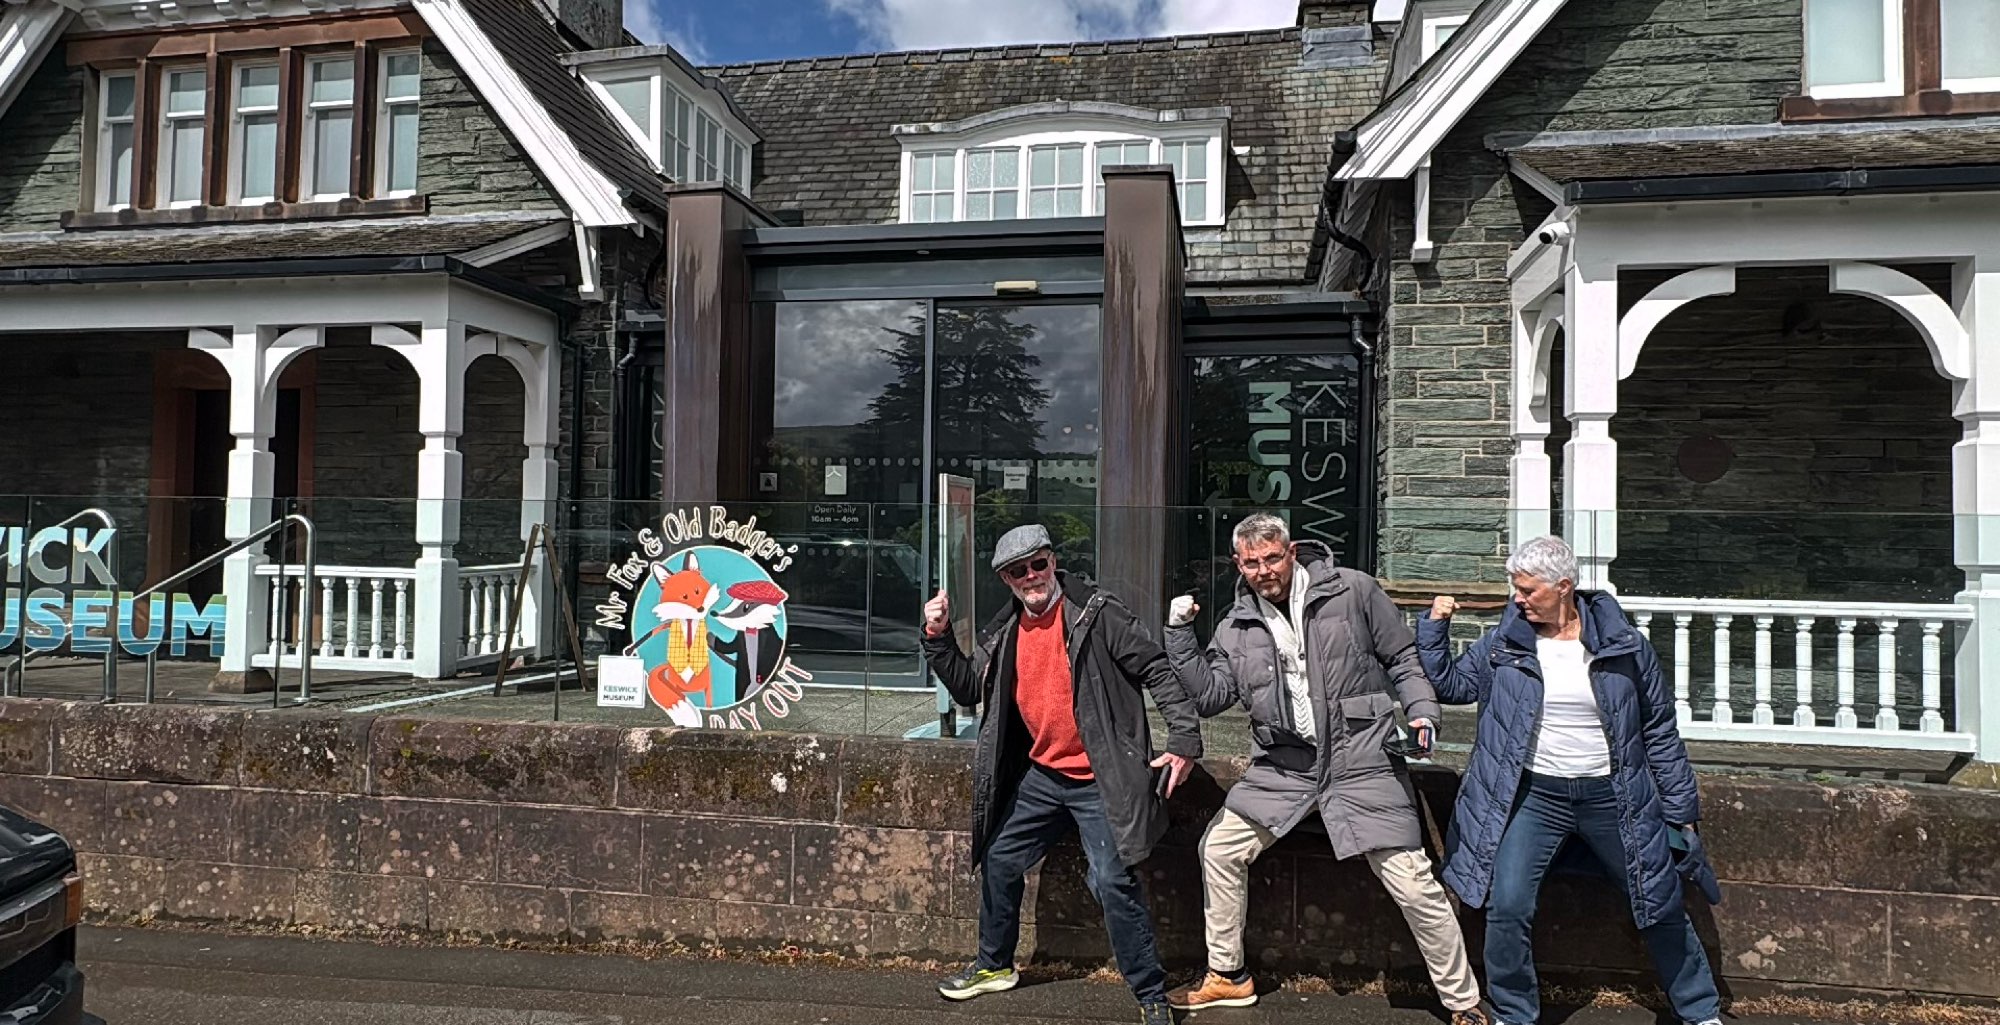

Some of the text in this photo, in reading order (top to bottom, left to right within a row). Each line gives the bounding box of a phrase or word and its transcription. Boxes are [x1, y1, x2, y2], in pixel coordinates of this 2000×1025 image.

[1248, 381, 1291, 530] MUS
[1302, 380, 1347, 556] KESW
[0, 527, 117, 585] ICK
[595, 506, 798, 630] Mr Fox & Old Badger's
[603, 685, 638, 693] KESWICK
[762, 656, 813, 718] OUT
